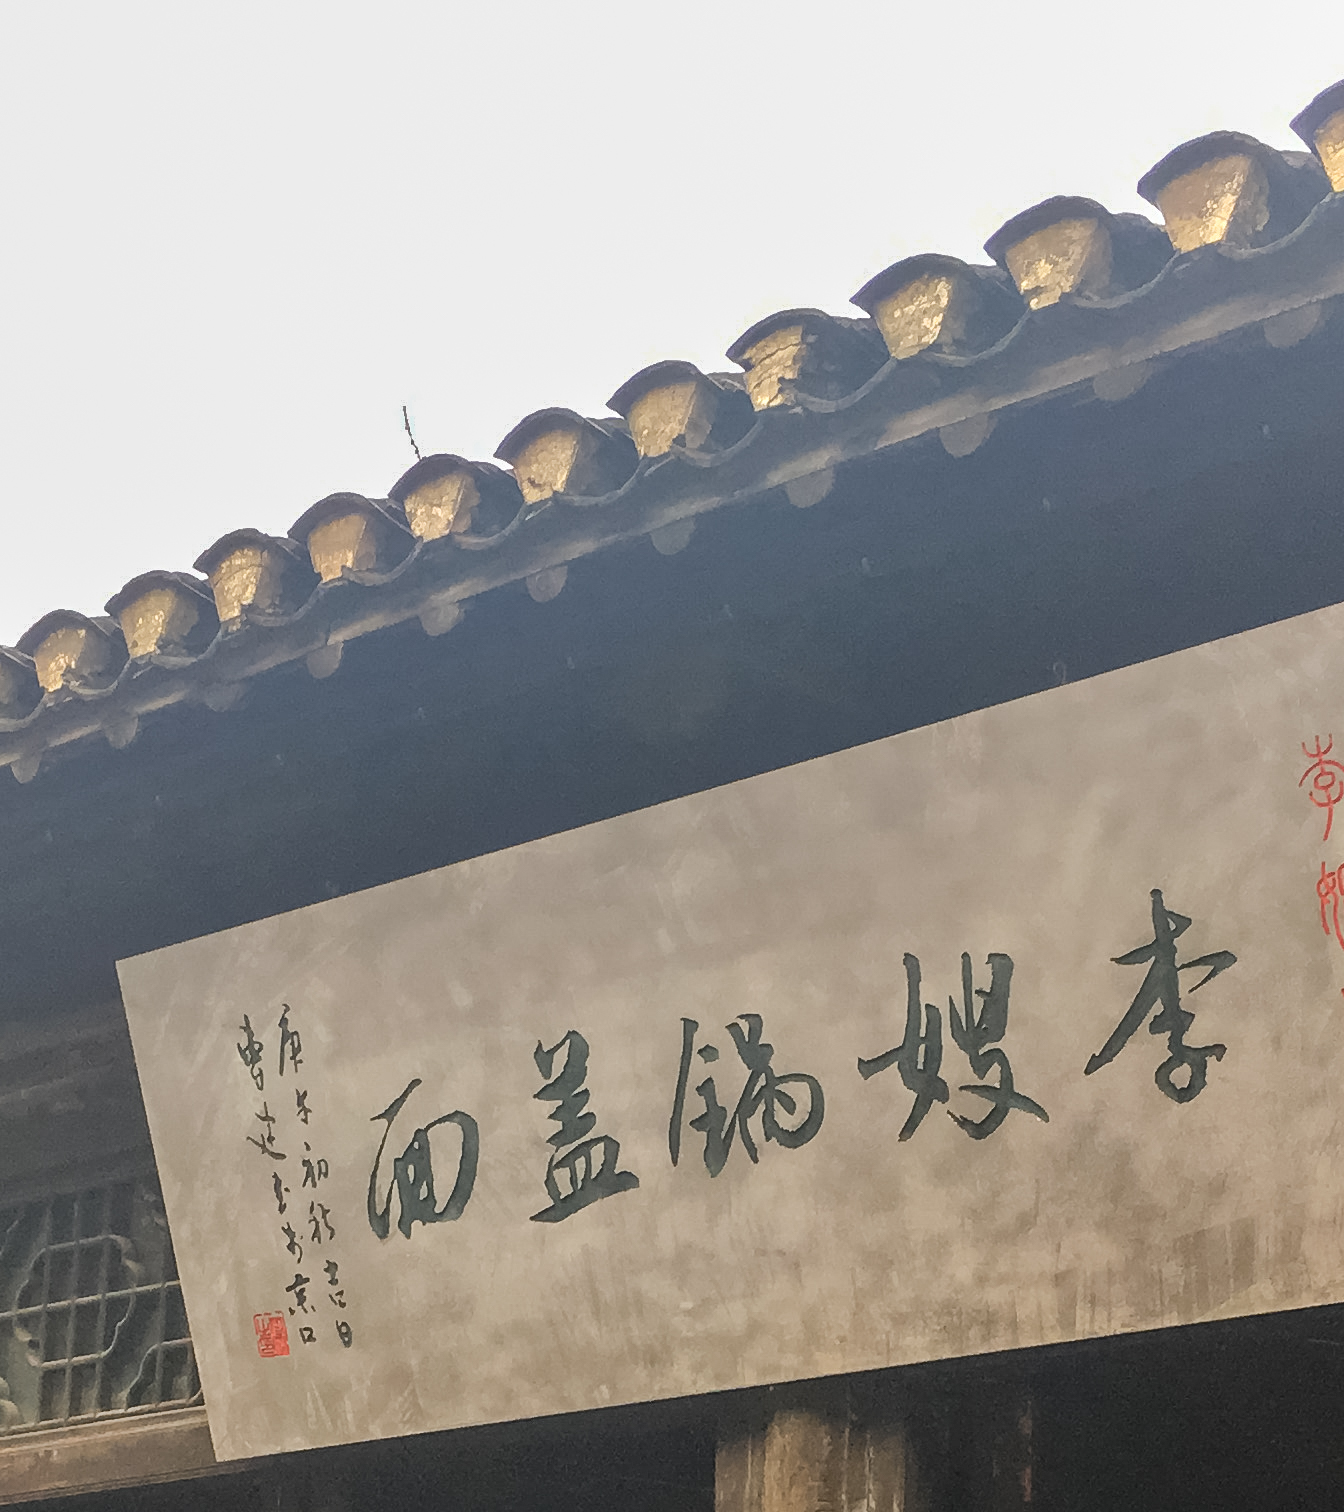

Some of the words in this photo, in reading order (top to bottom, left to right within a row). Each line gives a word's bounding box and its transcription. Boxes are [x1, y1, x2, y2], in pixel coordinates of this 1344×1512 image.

[366, 889, 1238, 1241] 李嫂锅盖面
